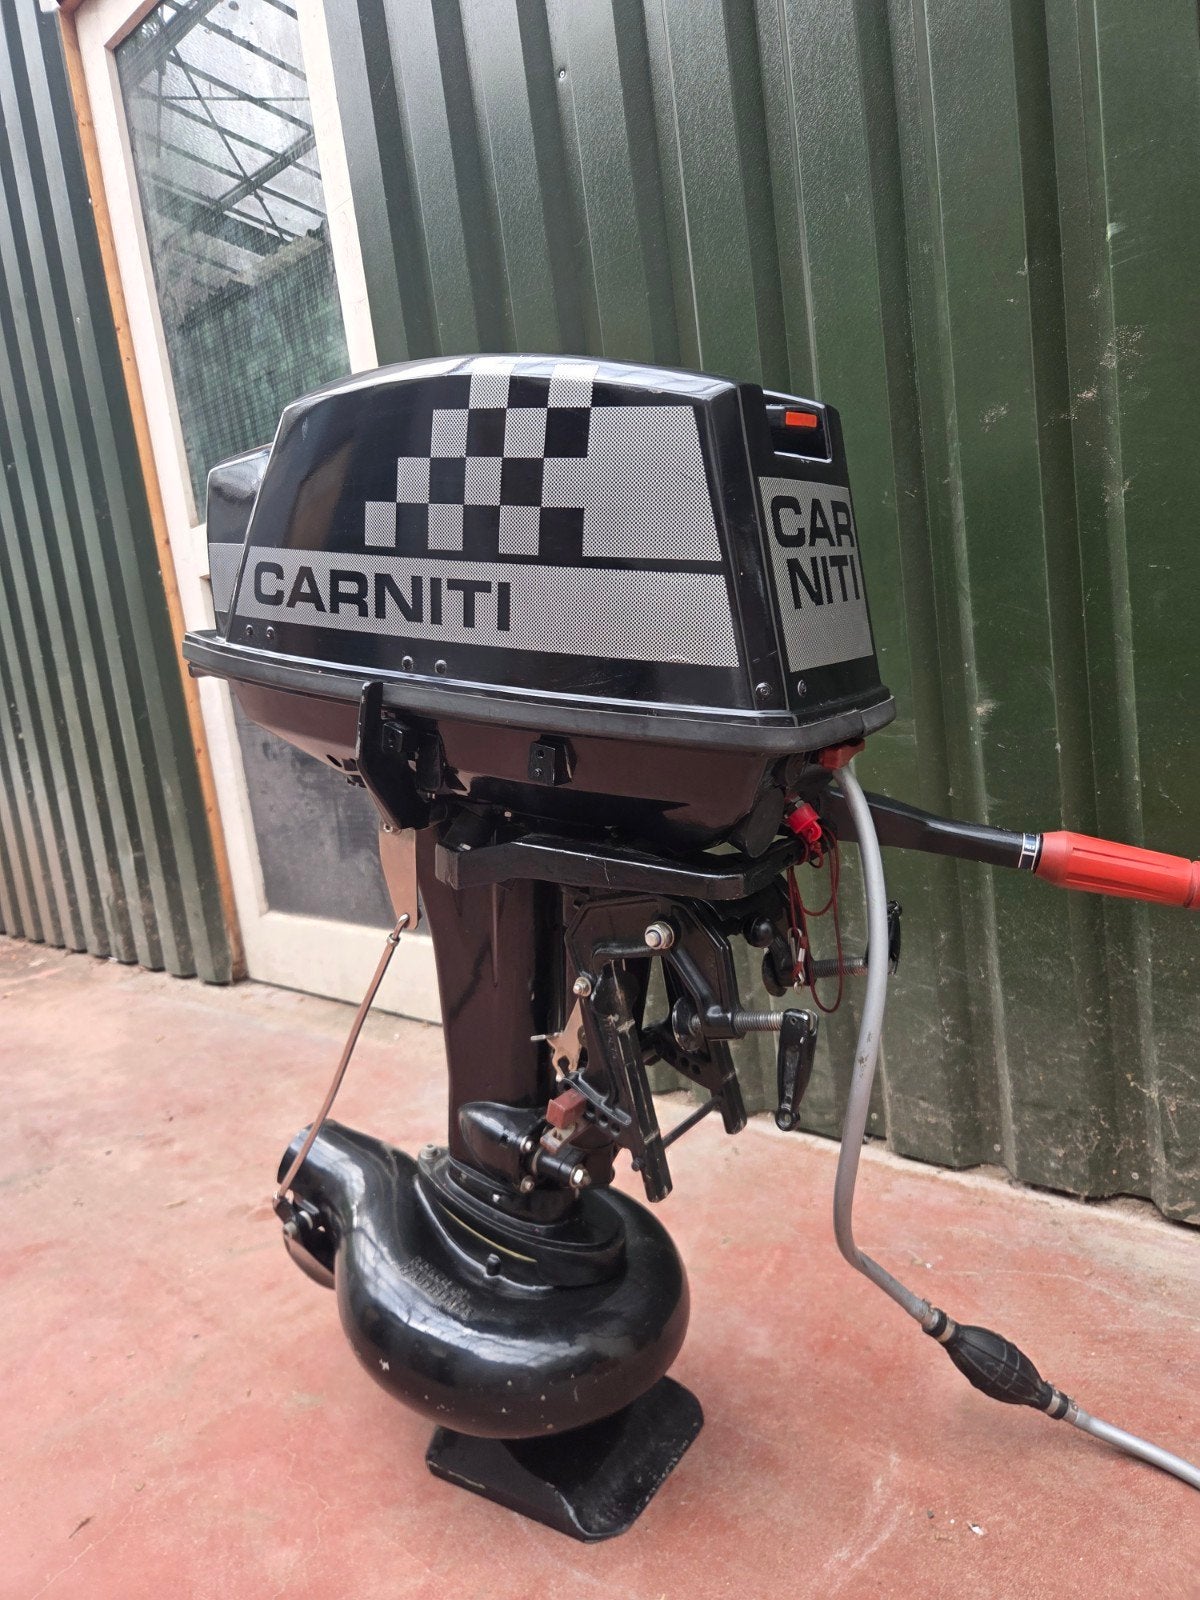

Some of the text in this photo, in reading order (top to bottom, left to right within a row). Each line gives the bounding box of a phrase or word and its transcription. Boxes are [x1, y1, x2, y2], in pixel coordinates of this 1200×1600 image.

[771, 495, 855, 548] CAR
[253, 561, 511, 632] CARNITI
[786, 554, 860, 610] NITI
